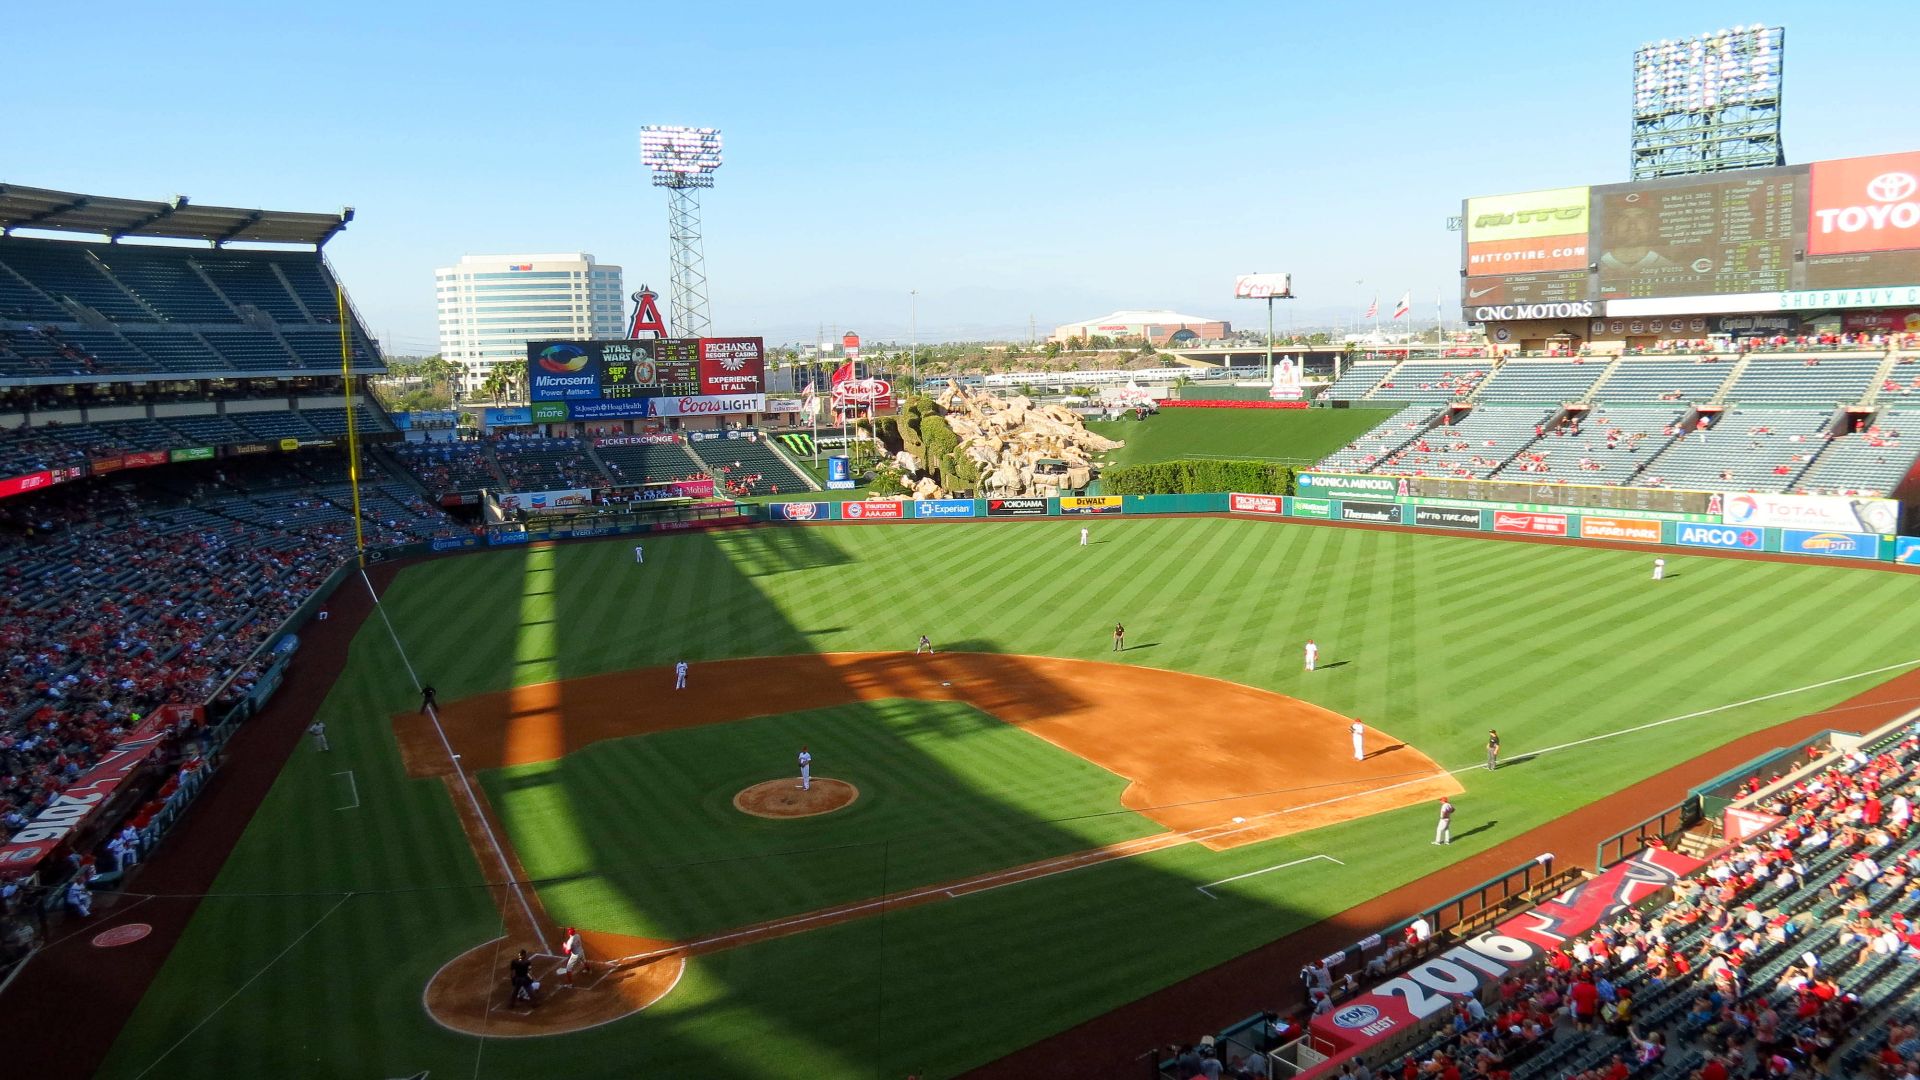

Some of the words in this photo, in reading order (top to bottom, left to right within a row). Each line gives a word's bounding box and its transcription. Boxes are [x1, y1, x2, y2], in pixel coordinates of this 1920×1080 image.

[1471, 247, 1585, 263] NITTOTIRE.COM
[1476, 307, 1513, 321] CNC
[1517, 303, 1592, 319] MOTORS
[1671, 320, 1682, 328] 42
[602, 345, 631, 353] STAR
[705, 342, 757, 352] PECHANGA
[602, 353, 632, 362] WARS
[608, 367, 628, 375] SEPT
[536, 375, 594, 387] Microsemi
[708, 376, 758, 384] EXPERIENCE
[541, 389, 563, 397] Power
[844, 385, 881, 394] Yakut
[679, 396, 721, 413] Coors
[722, 400, 758, 411] LIGHT
[537, 410, 563, 418] more
[600, 437, 629, 446] TICKET
[1312, 477, 1349, 488] KONICA
[1350, 479, 1394, 490] MINOLTA
[1235, 496, 1276, 505] PECHANGA
[934, 504, 970, 514] Experian
[1300, 502, 1328, 511] National
[1767, 503, 1830, 518] TOTAL
[1344, 508, 1391, 520] Thermador
[1417, 511, 1441, 520] NITTO
[1584, 525, 1625, 536] SAFARI
[1626, 527, 1657, 539] PARK
[1682, 527, 1737, 545] ARCO
[1371, 931, 1533, 1019] 2016
[1341, 1005, 1368, 1022] FOX
[1360, 1016, 1395, 1037] WEST
